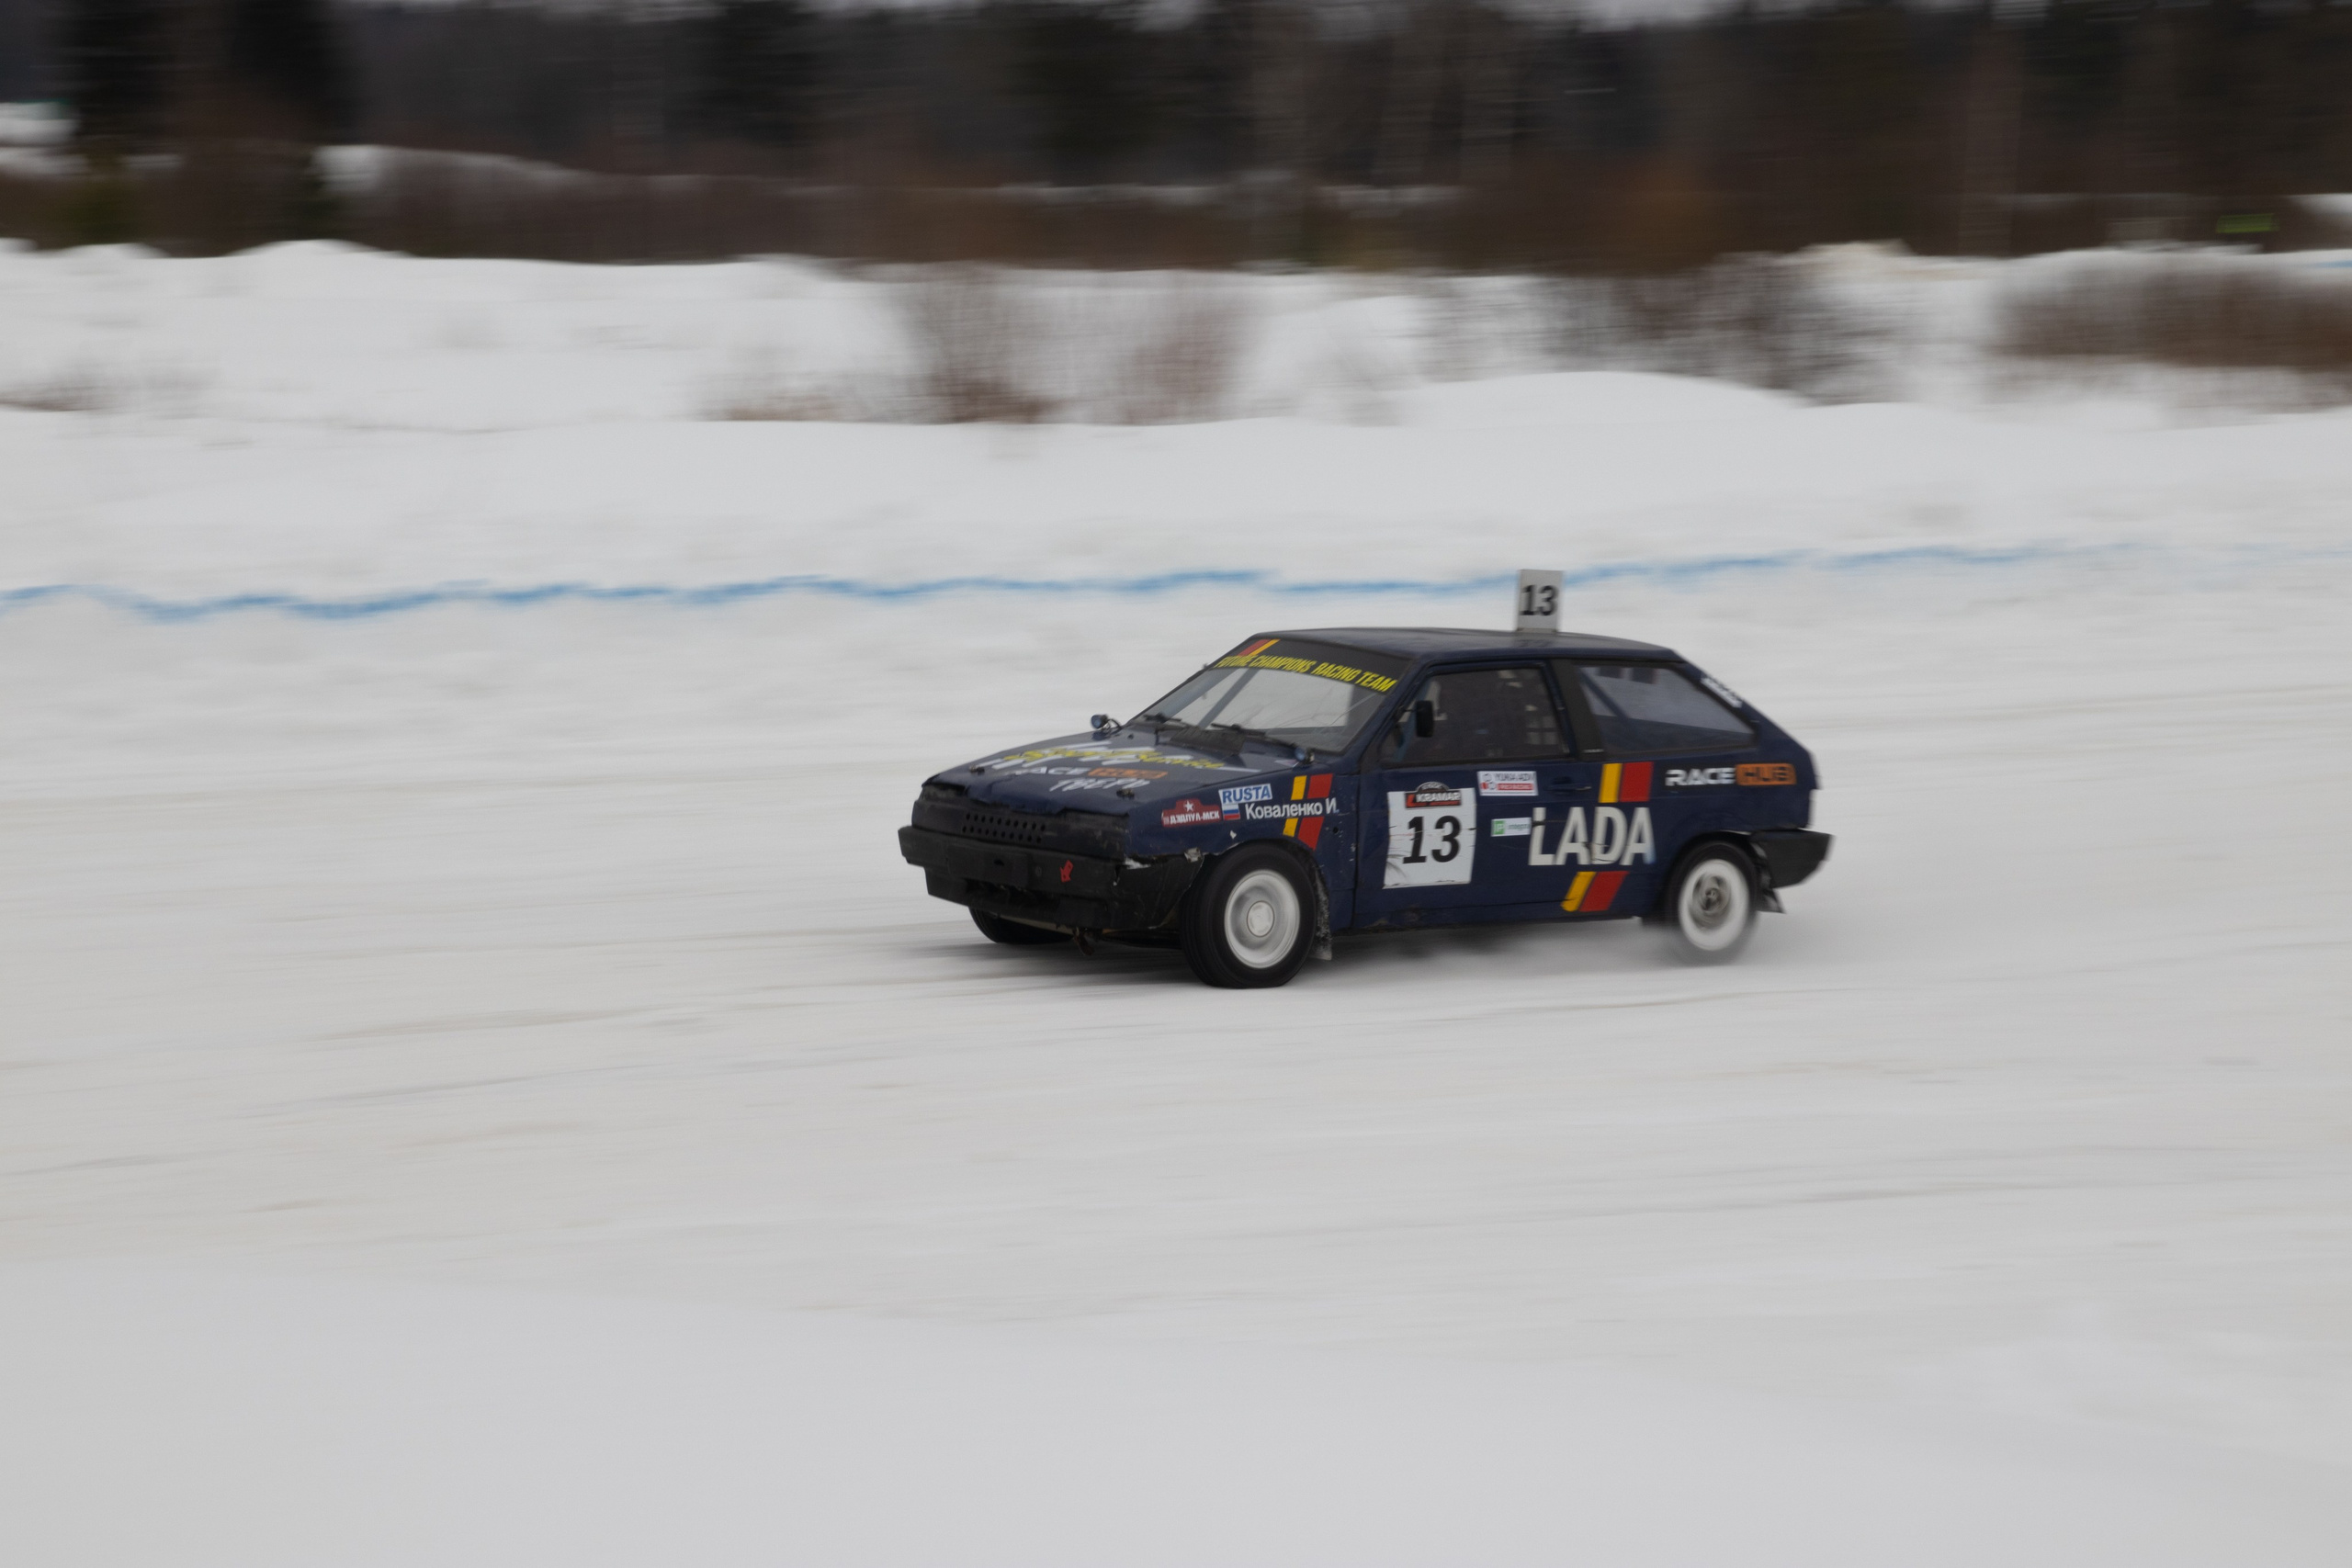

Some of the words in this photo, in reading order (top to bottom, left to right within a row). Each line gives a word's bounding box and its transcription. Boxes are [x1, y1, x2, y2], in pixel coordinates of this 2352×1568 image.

[1520, 584, 1559, 616] 13
[1249, 655, 1317, 673] CHAMPIONS
[1311, 662, 1362, 682] RACING
[1355, 671, 1399, 693] TEAM
[1665, 767, 1736, 786] RACE
[1222, 785, 1271, 804] RUSTA
[1416, 792, 1461, 803] KRAMAR
[1245, 802, 1323, 820] Коваленко
[1403, 815, 1462, 864] 13
[1528, 807, 1655, 866] LADA
